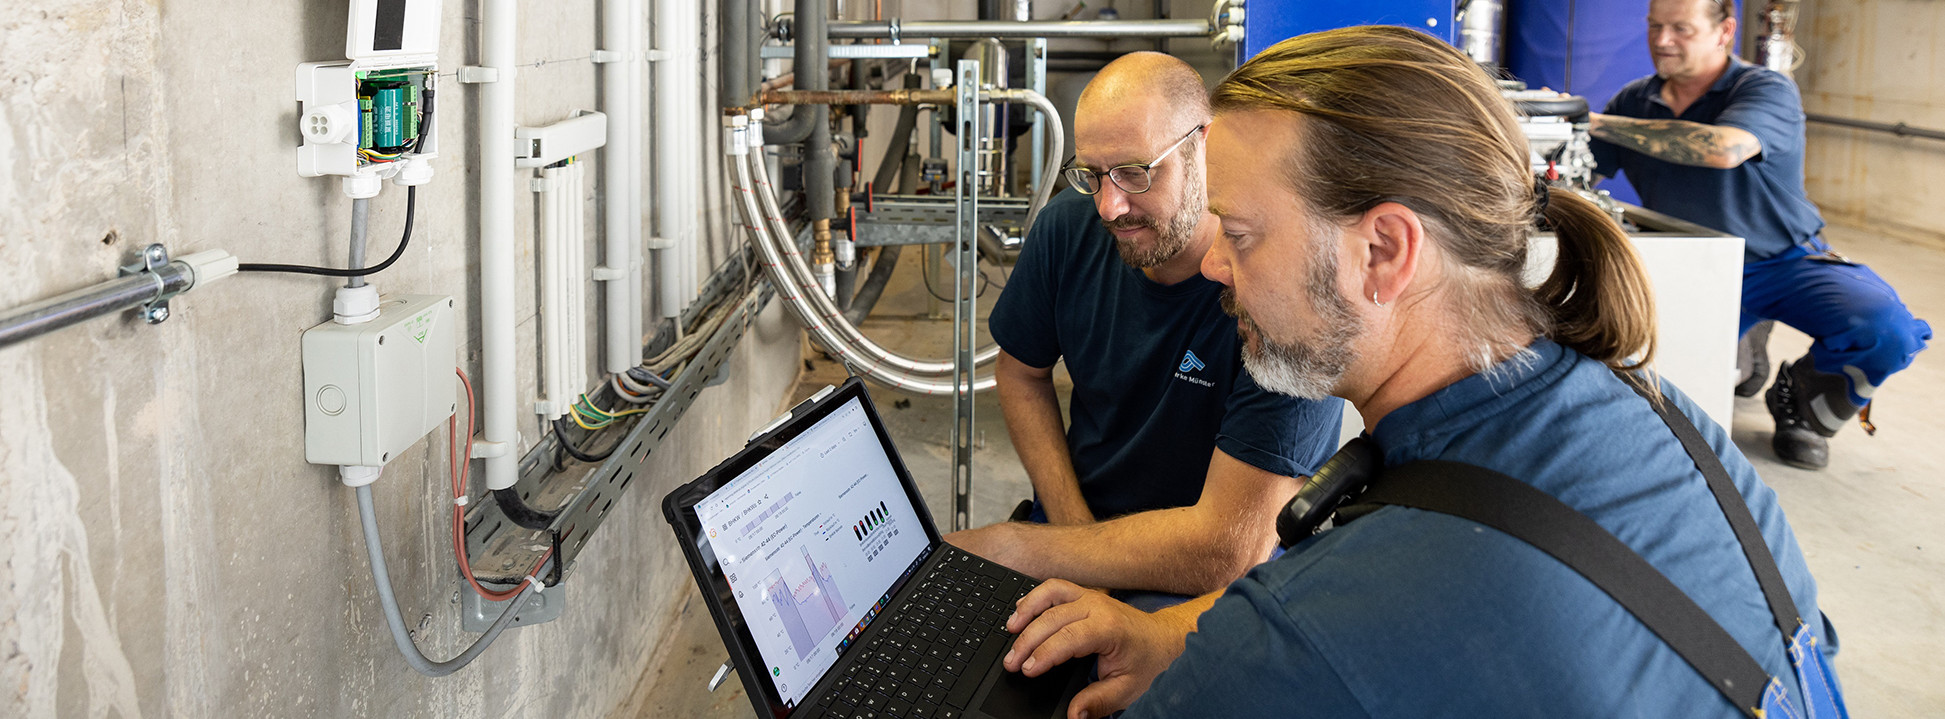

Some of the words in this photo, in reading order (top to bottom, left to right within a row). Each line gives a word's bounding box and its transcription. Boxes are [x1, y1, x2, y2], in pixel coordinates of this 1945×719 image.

[1188, 376, 1216, 388] Münster
[760, 537, 770, 547] 42-44
[770, 523, 787, 539] (EC-Power)
[780, 539, 788, 548] 42-44
